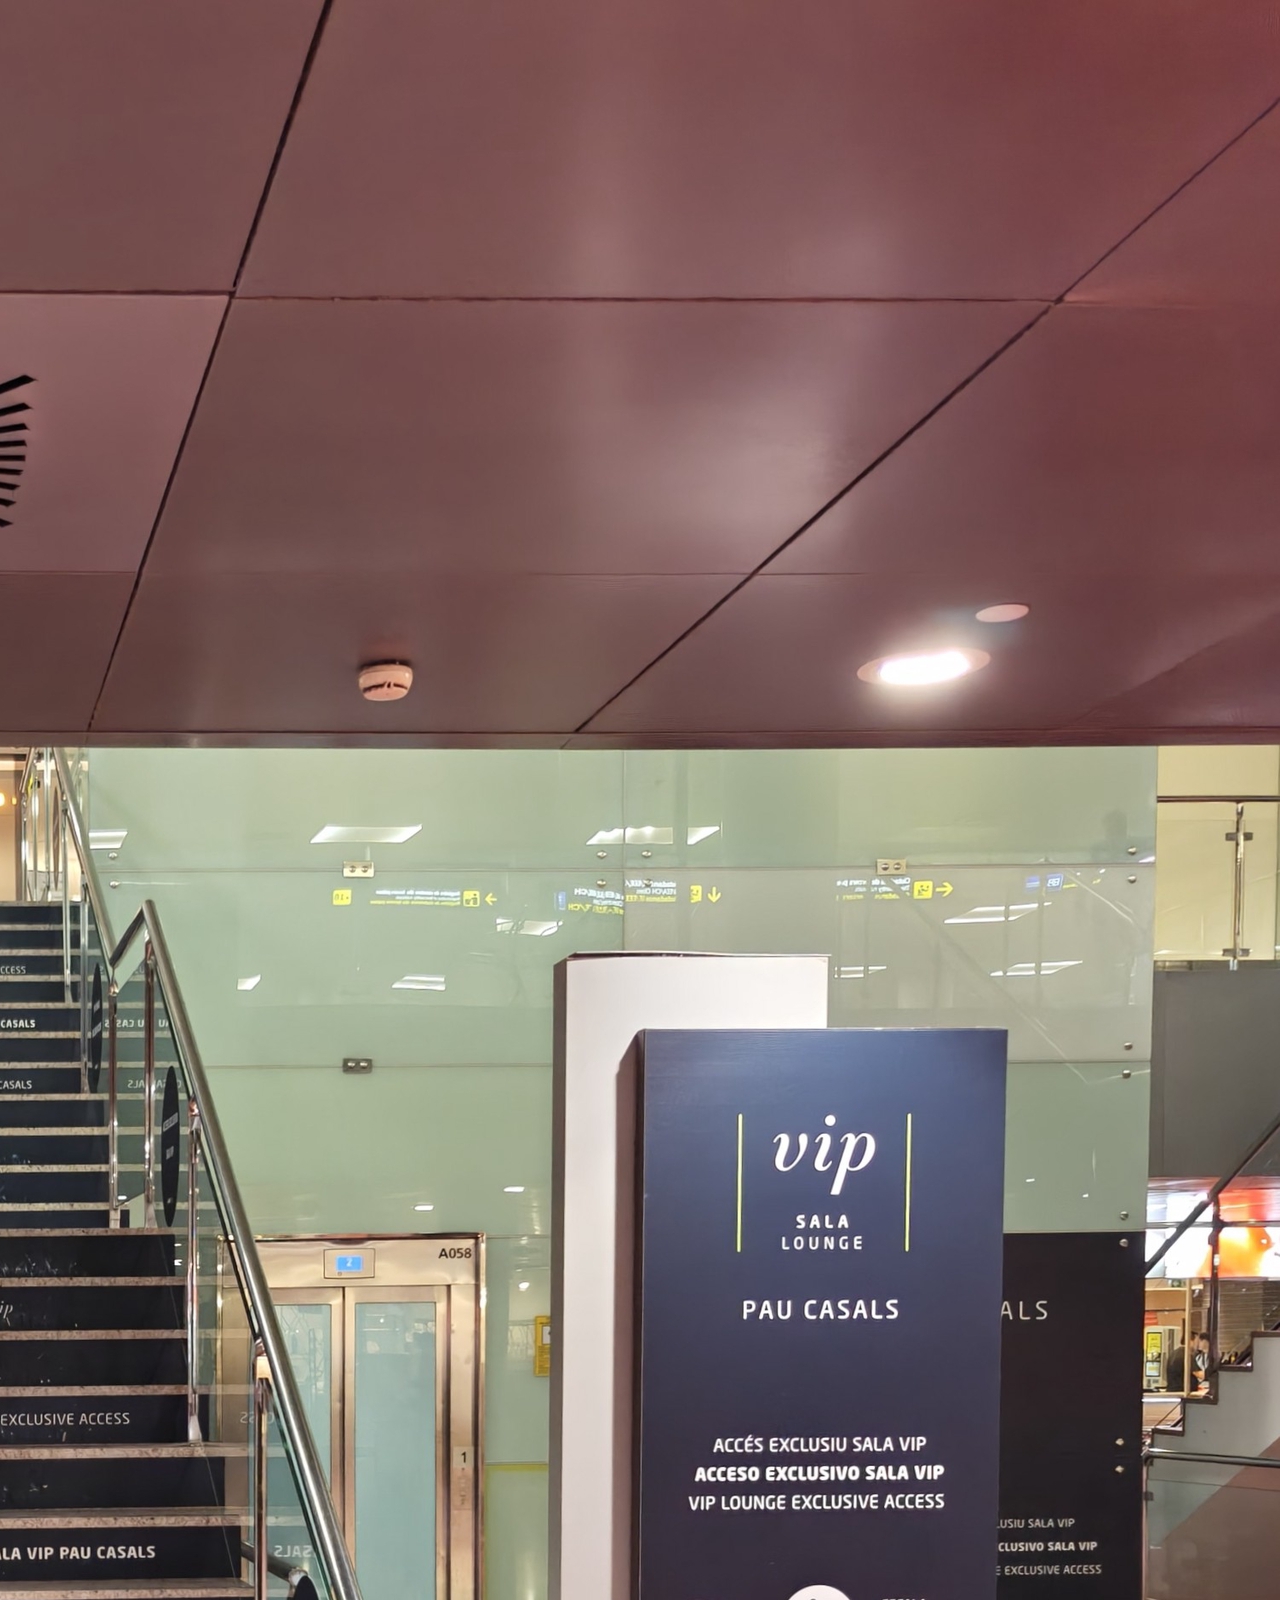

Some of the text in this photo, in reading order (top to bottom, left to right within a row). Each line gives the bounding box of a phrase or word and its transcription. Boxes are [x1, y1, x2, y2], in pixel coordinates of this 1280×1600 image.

[1, 1020, 35, 1028] CASALS
[773, 1115, 875, 1195] vip
[797, 1215, 848, 1228] SALA
[782, 1236, 862, 1250] LOUNGE
[438, 1247, 472, 1259] A058
[743, 1300, 898, 1319] PAU CASALS
[1, 1413, 73, 1426] EXCLUSIVE
[79, 1413, 129, 1424] ACCESS
[713, 1435, 926, 1452] ACCÉS EXCLUSIU SALA VIP
[460, 1451, 467, 1463] 1
[695, 1465, 944, 1481] ACCESO EXCLUSIVO SALA VIP
[689, 1494, 944, 1510] VIP LOUNGE EXCLUSIVE ACCESS
[1028, 1519, 1054, 1528] SALA
[1058, 1518, 1075, 1527] VIP
[27, 1547, 53, 1559] VIP
[60, 1547, 90, 1559] PAU
[97, 1546, 155, 1558] CASALS
[998, 1542, 1097, 1551] CLUSIVO SALA VIP
[1005, 1565, 1059, 1575] EXCLUSIVE
[1063, 1565, 1101, 1574] ACCESS
